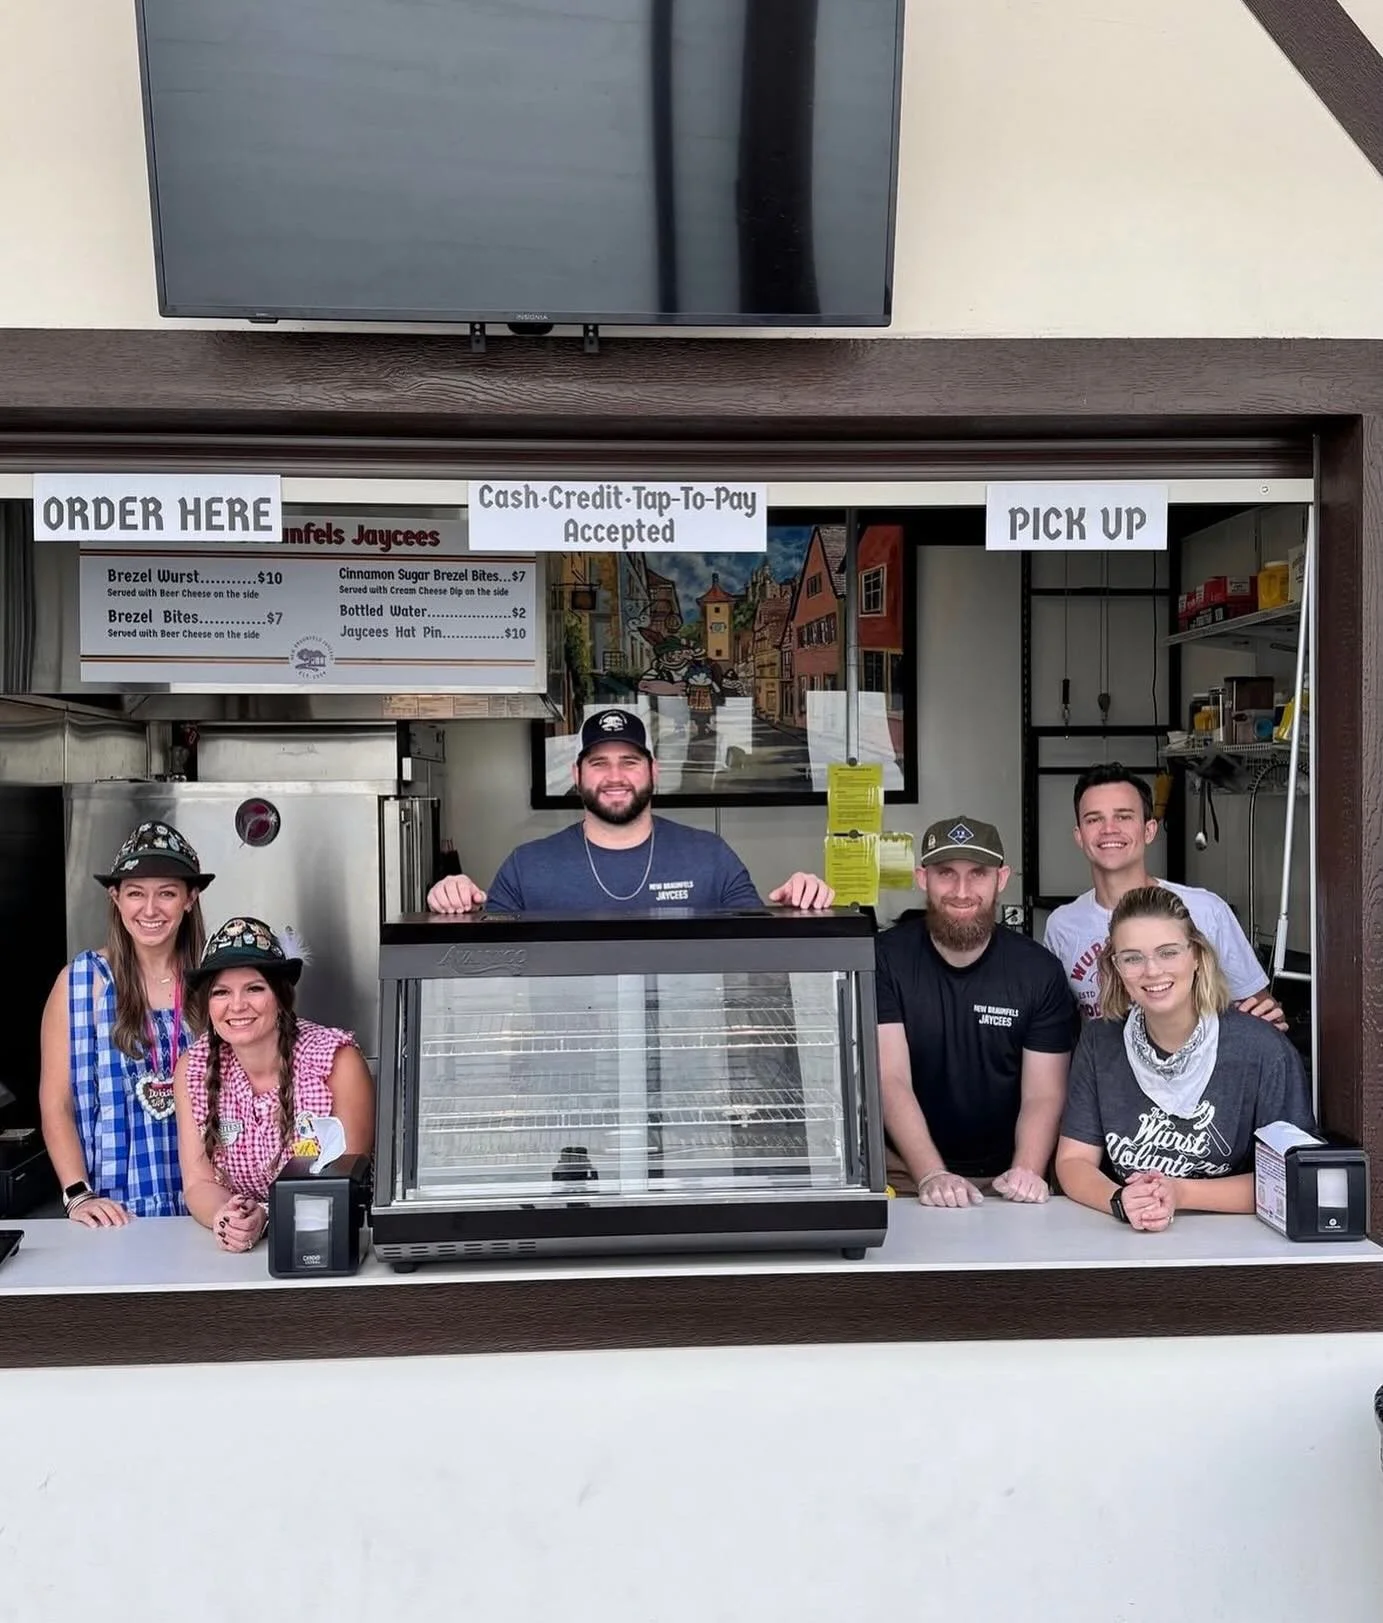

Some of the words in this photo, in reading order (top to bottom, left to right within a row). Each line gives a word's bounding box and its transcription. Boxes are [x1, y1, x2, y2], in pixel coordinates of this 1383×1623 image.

[43, 496, 164, 531] ORDER
[177, 496, 273, 532] HERE
[1008, 506, 1086, 541] PICK
[1100, 506, 1147, 541] UP
[352, 524, 441, 553] Jaycees
[563, 518, 675, 550] Accepted
[107, 568, 151, 583] Brezel
[339, 567, 395, 581] Cinnamon
[398, 568, 430, 584] Sugar
[433, 569, 468, 582] Brezel
[107, 588, 136, 598] Served
[138, 588, 157, 598] with
[159, 589, 179, 598] Beer
[181, 589, 211, 598] Cheese
[226, 589, 241, 599] the
[243, 589, 259, 599] side
[339, 585, 367, 595] Served
[369, 586, 388, 595] with
[390, 586, 416, 595] Cream
[418, 586, 447, 595] Cheese
[450, 587, 463, 597] Dip
[477, 587, 491, 596] the
[494, 587, 509, 596] side
[107, 609, 152, 623] Brezel
[340, 604, 383, 617] Bottled
[107, 629, 137, 638] Served
[138, 629, 158, 638] with
[160, 630, 179, 638] Beer
[182, 630, 212, 639] Cheese
[227, 630, 241, 639] the
[243, 630, 260, 639] side
[340, 626, 389, 641] Jaycees
[396, 626, 416, 638] Hat
[656, 889, 689, 901] JAYCEES
[978, 1014, 1013, 1027] JAYCEES
[1132, 1113, 1211, 1157] Wurst
